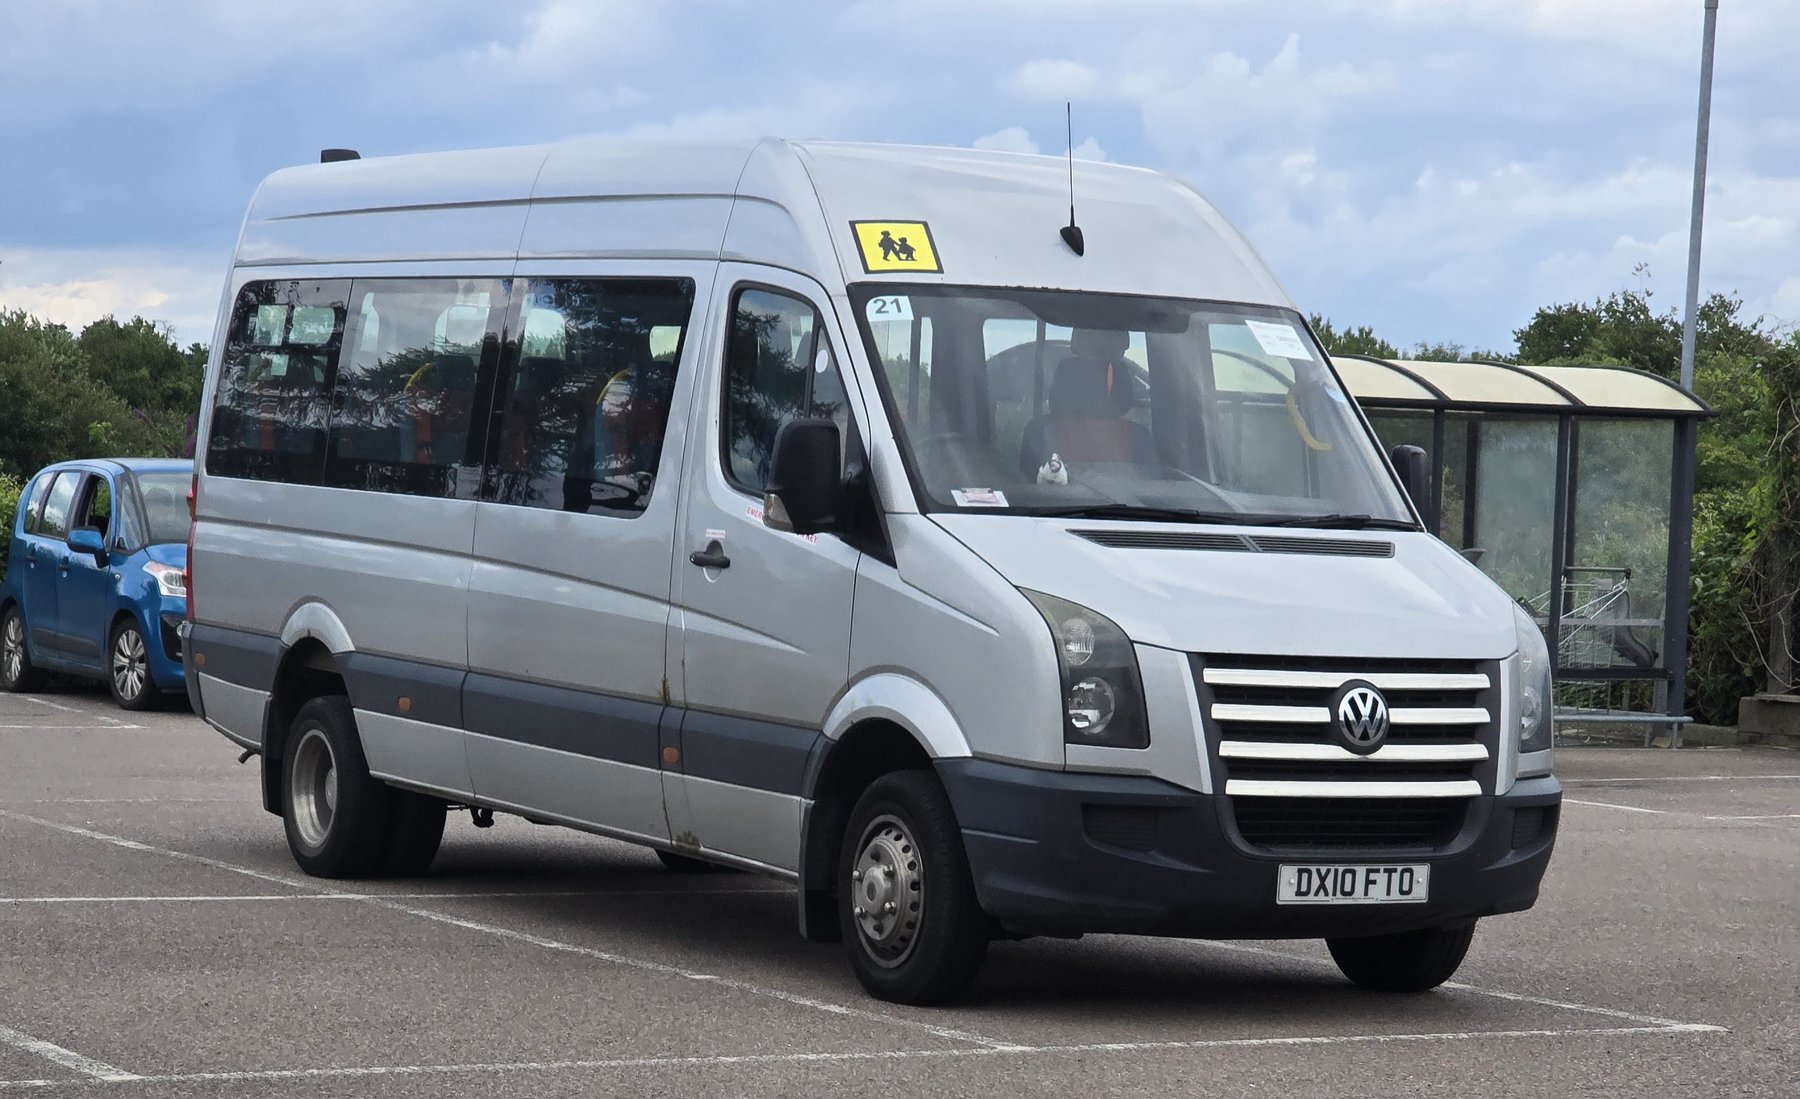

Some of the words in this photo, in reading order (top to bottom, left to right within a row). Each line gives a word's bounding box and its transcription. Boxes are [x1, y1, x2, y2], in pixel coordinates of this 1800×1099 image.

[873, 298, 902, 314] 21
[1339, 688, 1386, 746] VW
[1295, 867, 1357, 897] DX10
[1363, 867, 1414, 897] FTO
